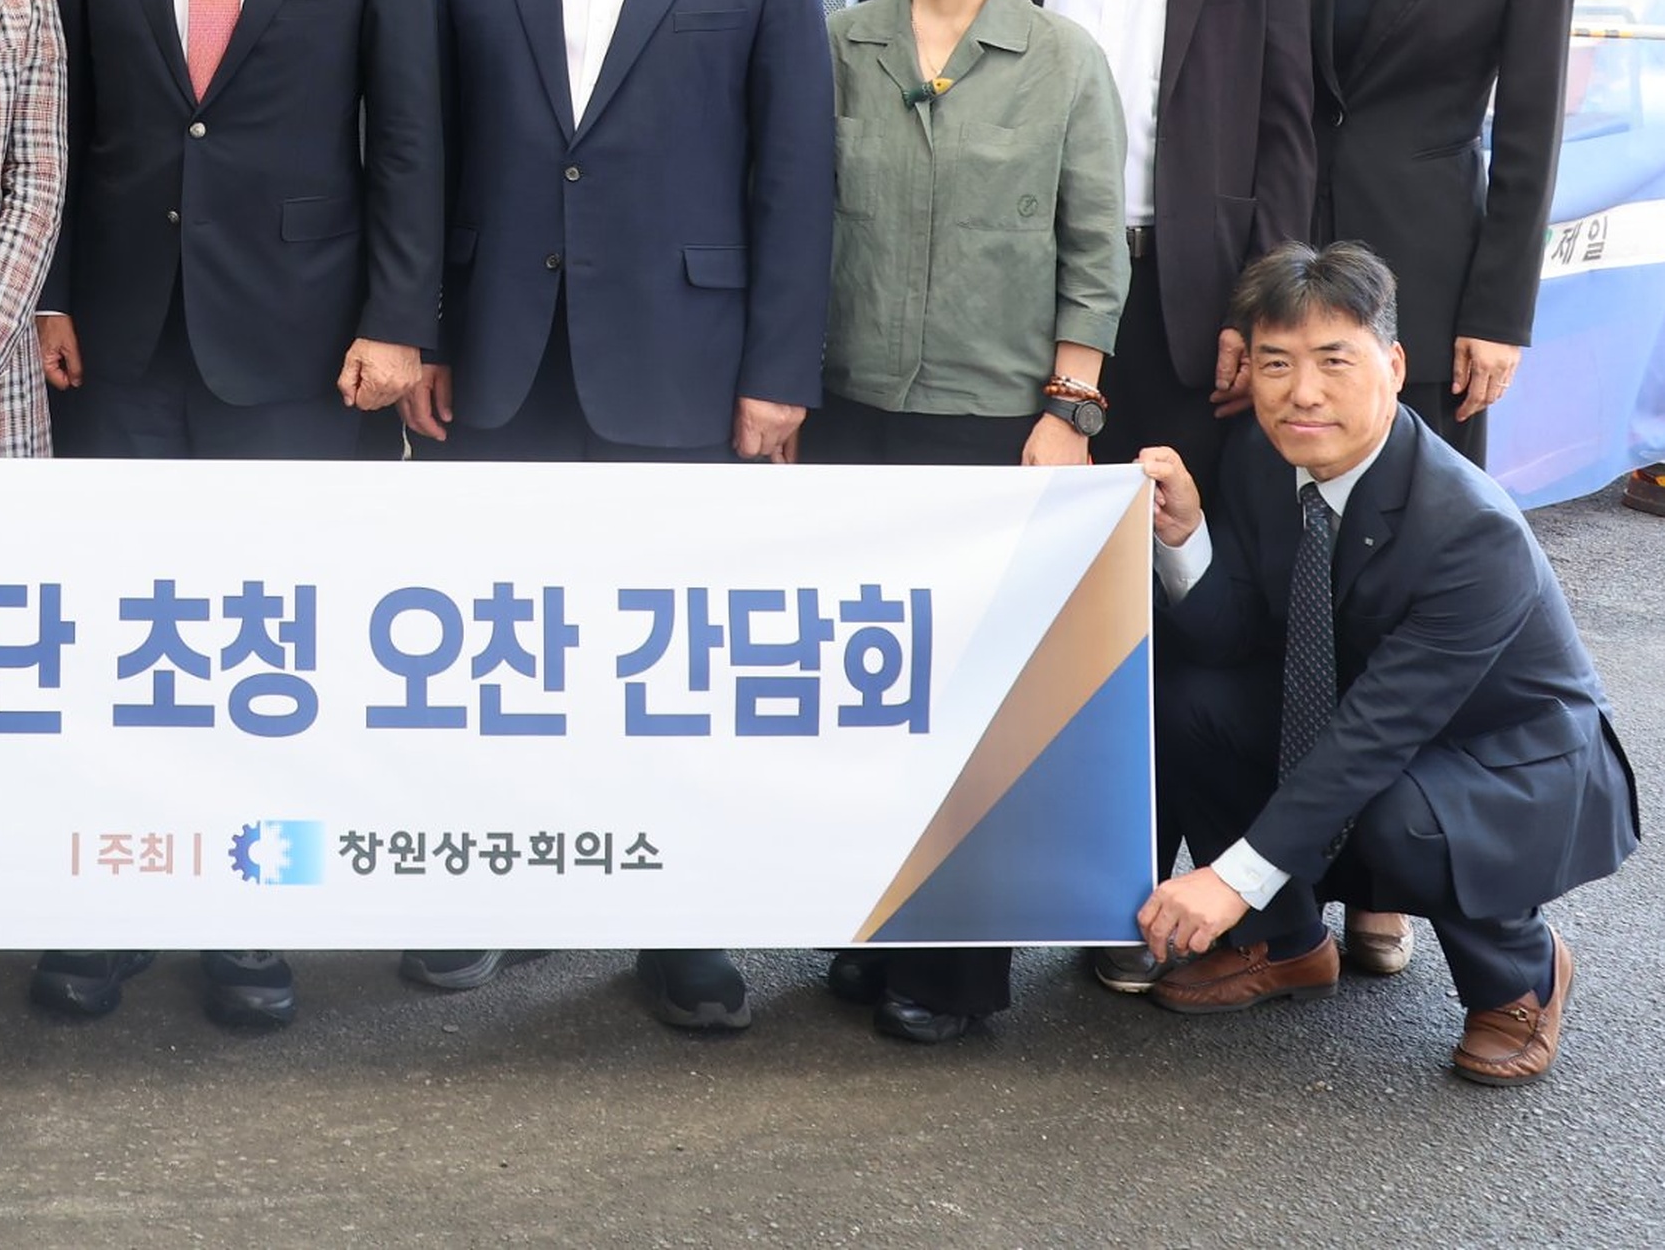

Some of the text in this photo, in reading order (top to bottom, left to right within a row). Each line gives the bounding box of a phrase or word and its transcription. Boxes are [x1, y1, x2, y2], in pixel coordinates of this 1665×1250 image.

[114, 580, 318, 736] 초청
[367, 582, 578, 735] 오찬
[616, 584, 931, 736] 간담회
[98, 832, 174, 875] 주최
[338, 829, 663, 876] 창원상공회의소
